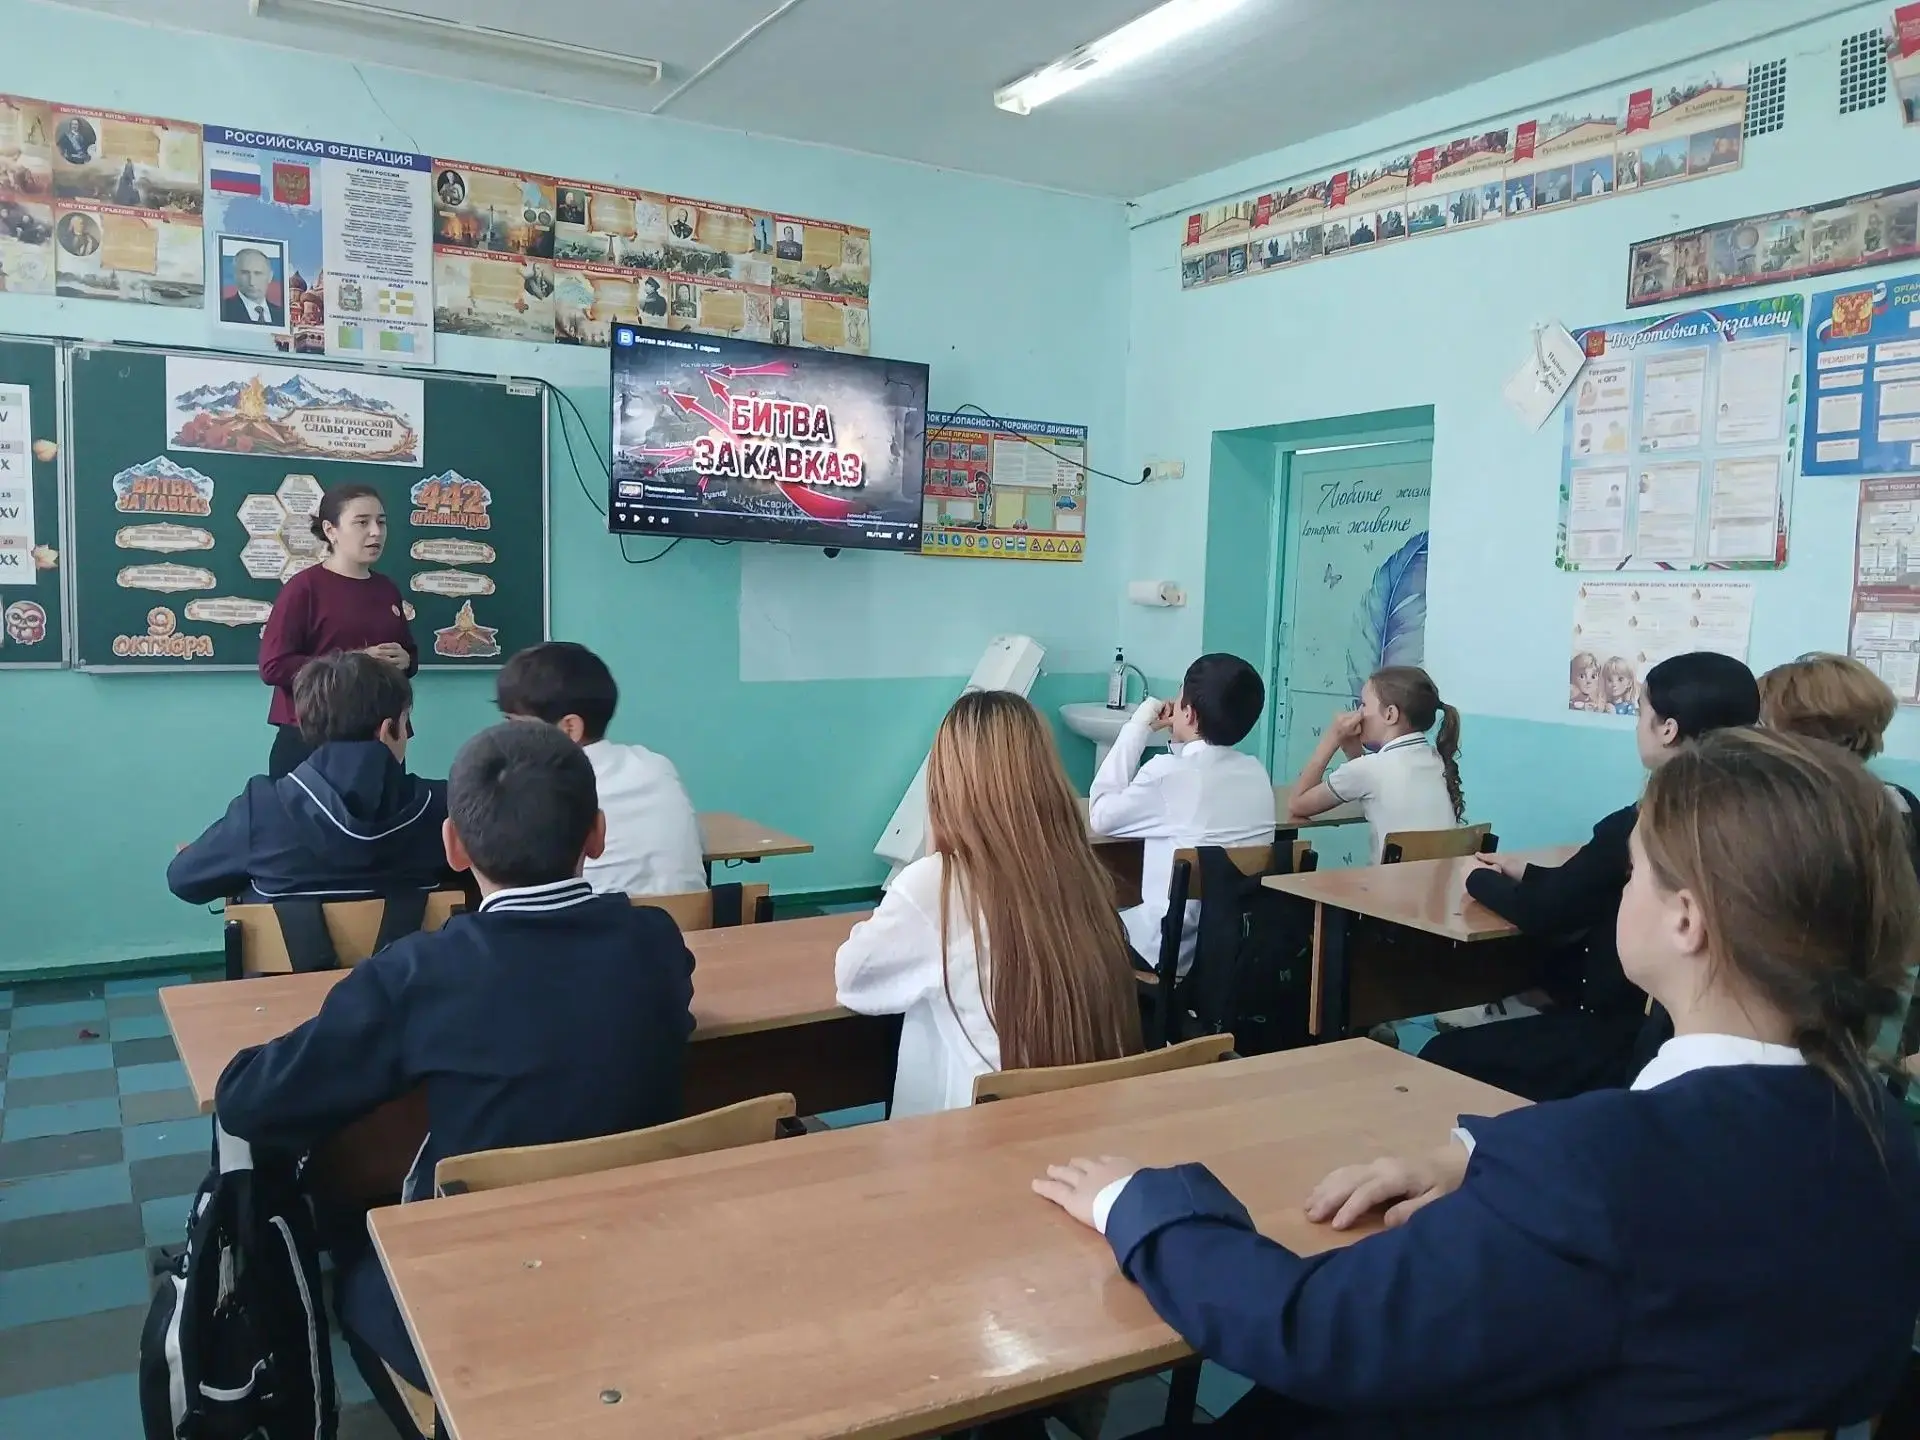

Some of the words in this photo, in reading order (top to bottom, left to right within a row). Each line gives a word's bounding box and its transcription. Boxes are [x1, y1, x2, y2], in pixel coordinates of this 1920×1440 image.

[224, 129, 324, 154] РОССИЙСКАЯ
[328, 144, 413, 167] ФЕДЕРАЦИЯ
[1894, 293, 1920, 307] РОС
[1610, 323, 1697, 349] Подготовка
[1699, 323, 1710, 335] к
[1713, 309, 1793, 334] экзамену
[301, 412, 332, 424] ДЕНЬ
[334, 414, 394, 429] ВОИНСКОЙ
[304, 423, 344, 435] СЛАВЫ
[347, 425, 393, 438] РОССИИ
[731, 397, 832, 442] БИТВА
[1046, 424, 1084, 436] ДВИЖЕНИЯ
[334, 440, 367, 449] ОКТЯБРЯ
[693, 436, 739, 477] ЗА
[742, 441, 862, 487] КАВКАЗ
[132, 477, 197, 497] БИТВА
[416, 480, 486, 514] 442
[1317, 480, 1384, 514] Любите
[413, 511, 467, 525] ОГНЕННЫХ
[467, 513, 489, 528] ДНЯ
[147, 606, 176, 636] 9
